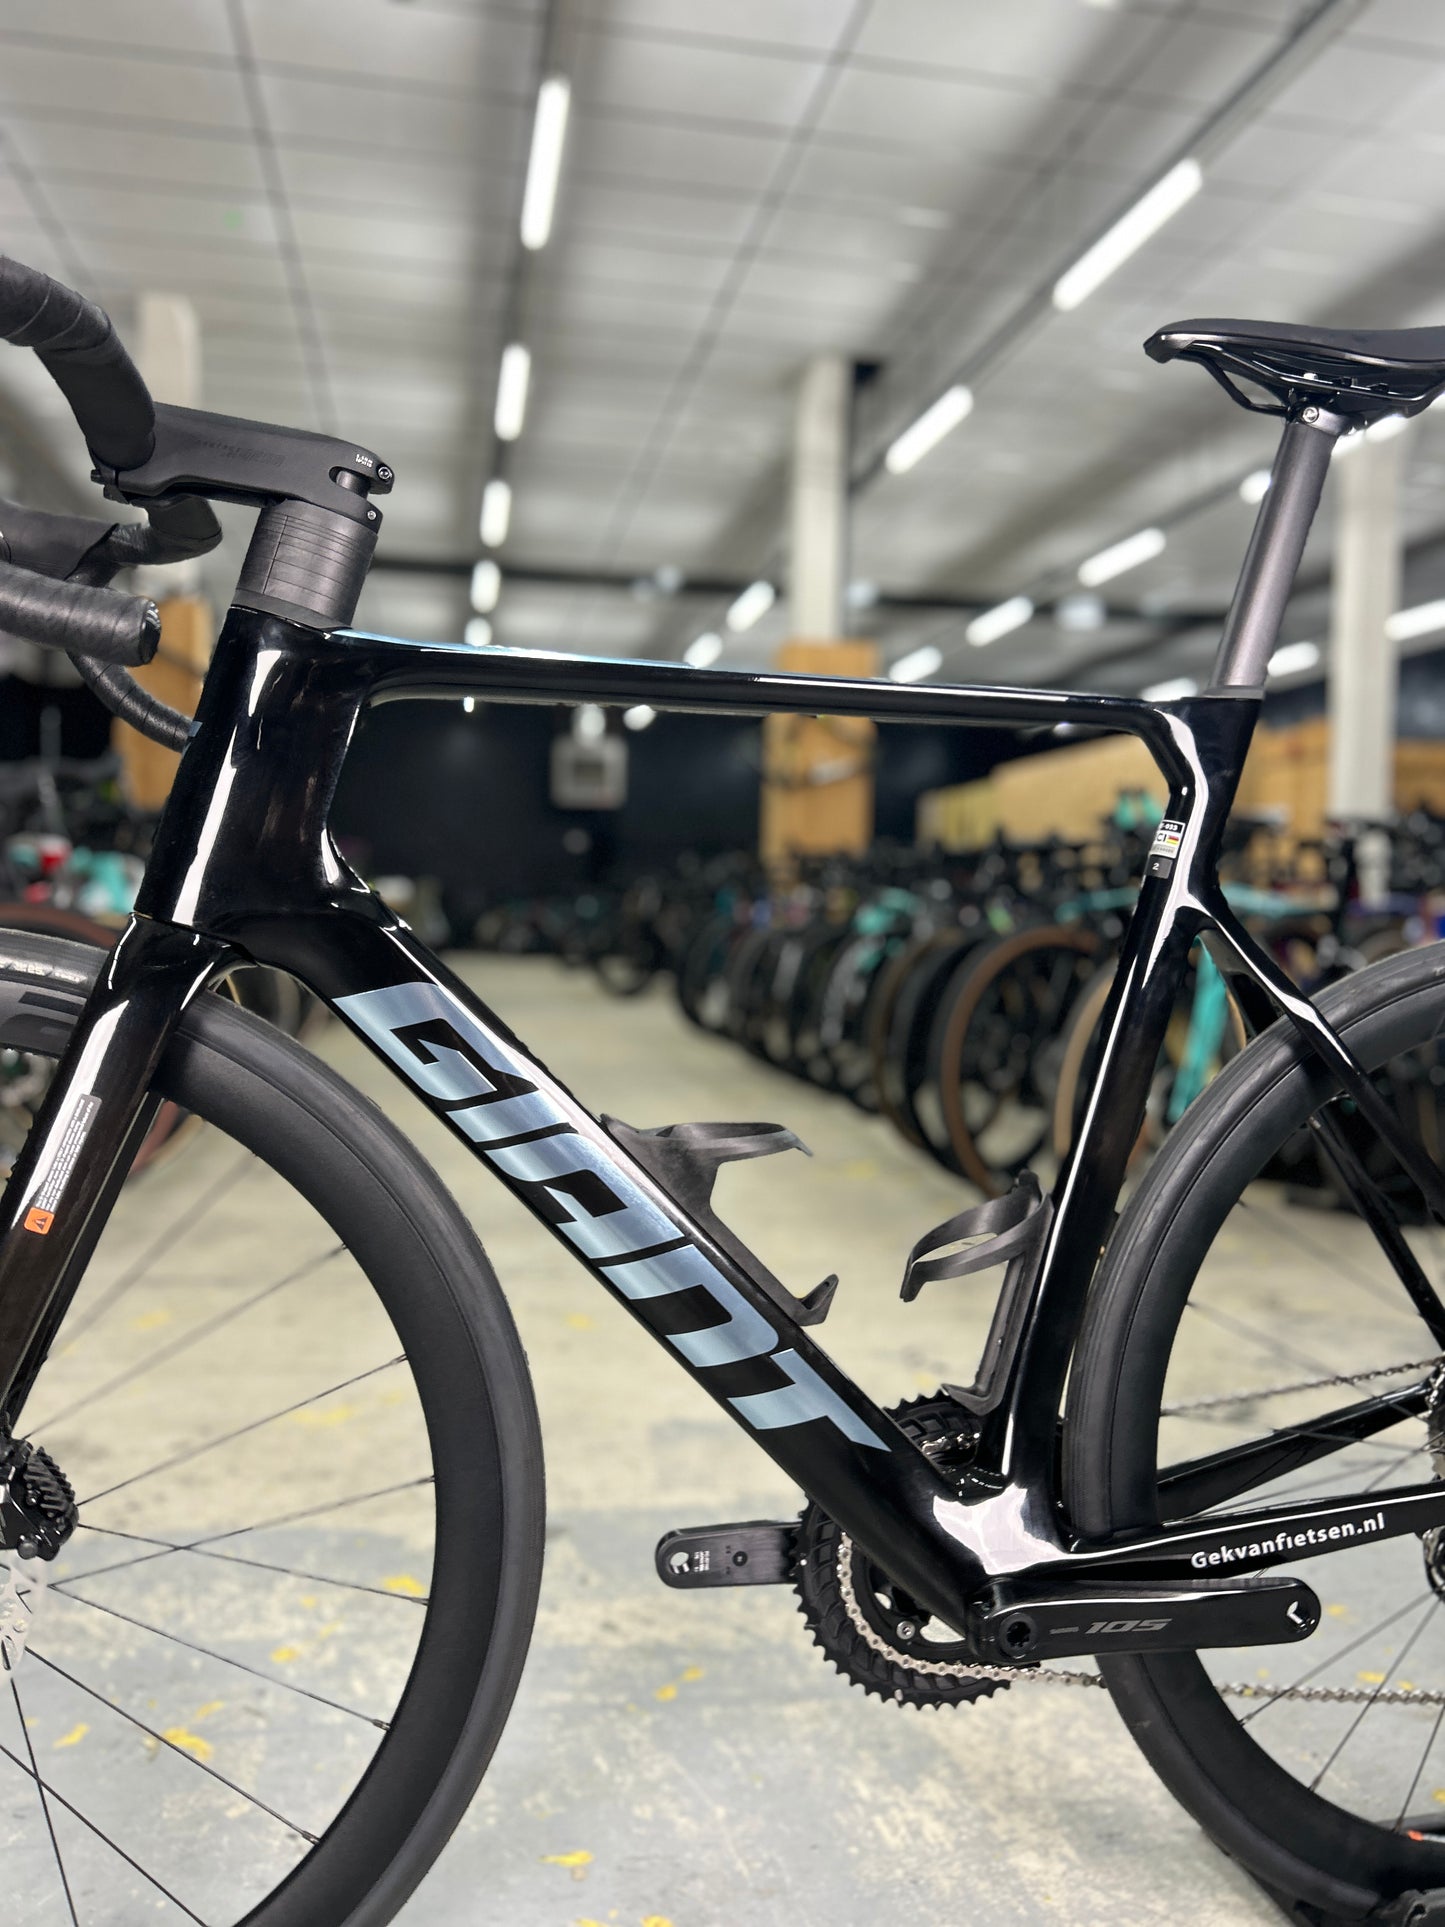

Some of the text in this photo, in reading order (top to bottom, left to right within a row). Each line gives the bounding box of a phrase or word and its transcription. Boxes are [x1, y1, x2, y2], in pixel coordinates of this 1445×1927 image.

[1152, 862, 1160, 871] 2
[332, 981, 892, 1452] GIANT
[1190, 1511, 1386, 1569] Gekvanfietsen.nl
[1085, 1618, 1173, 1634] 105
